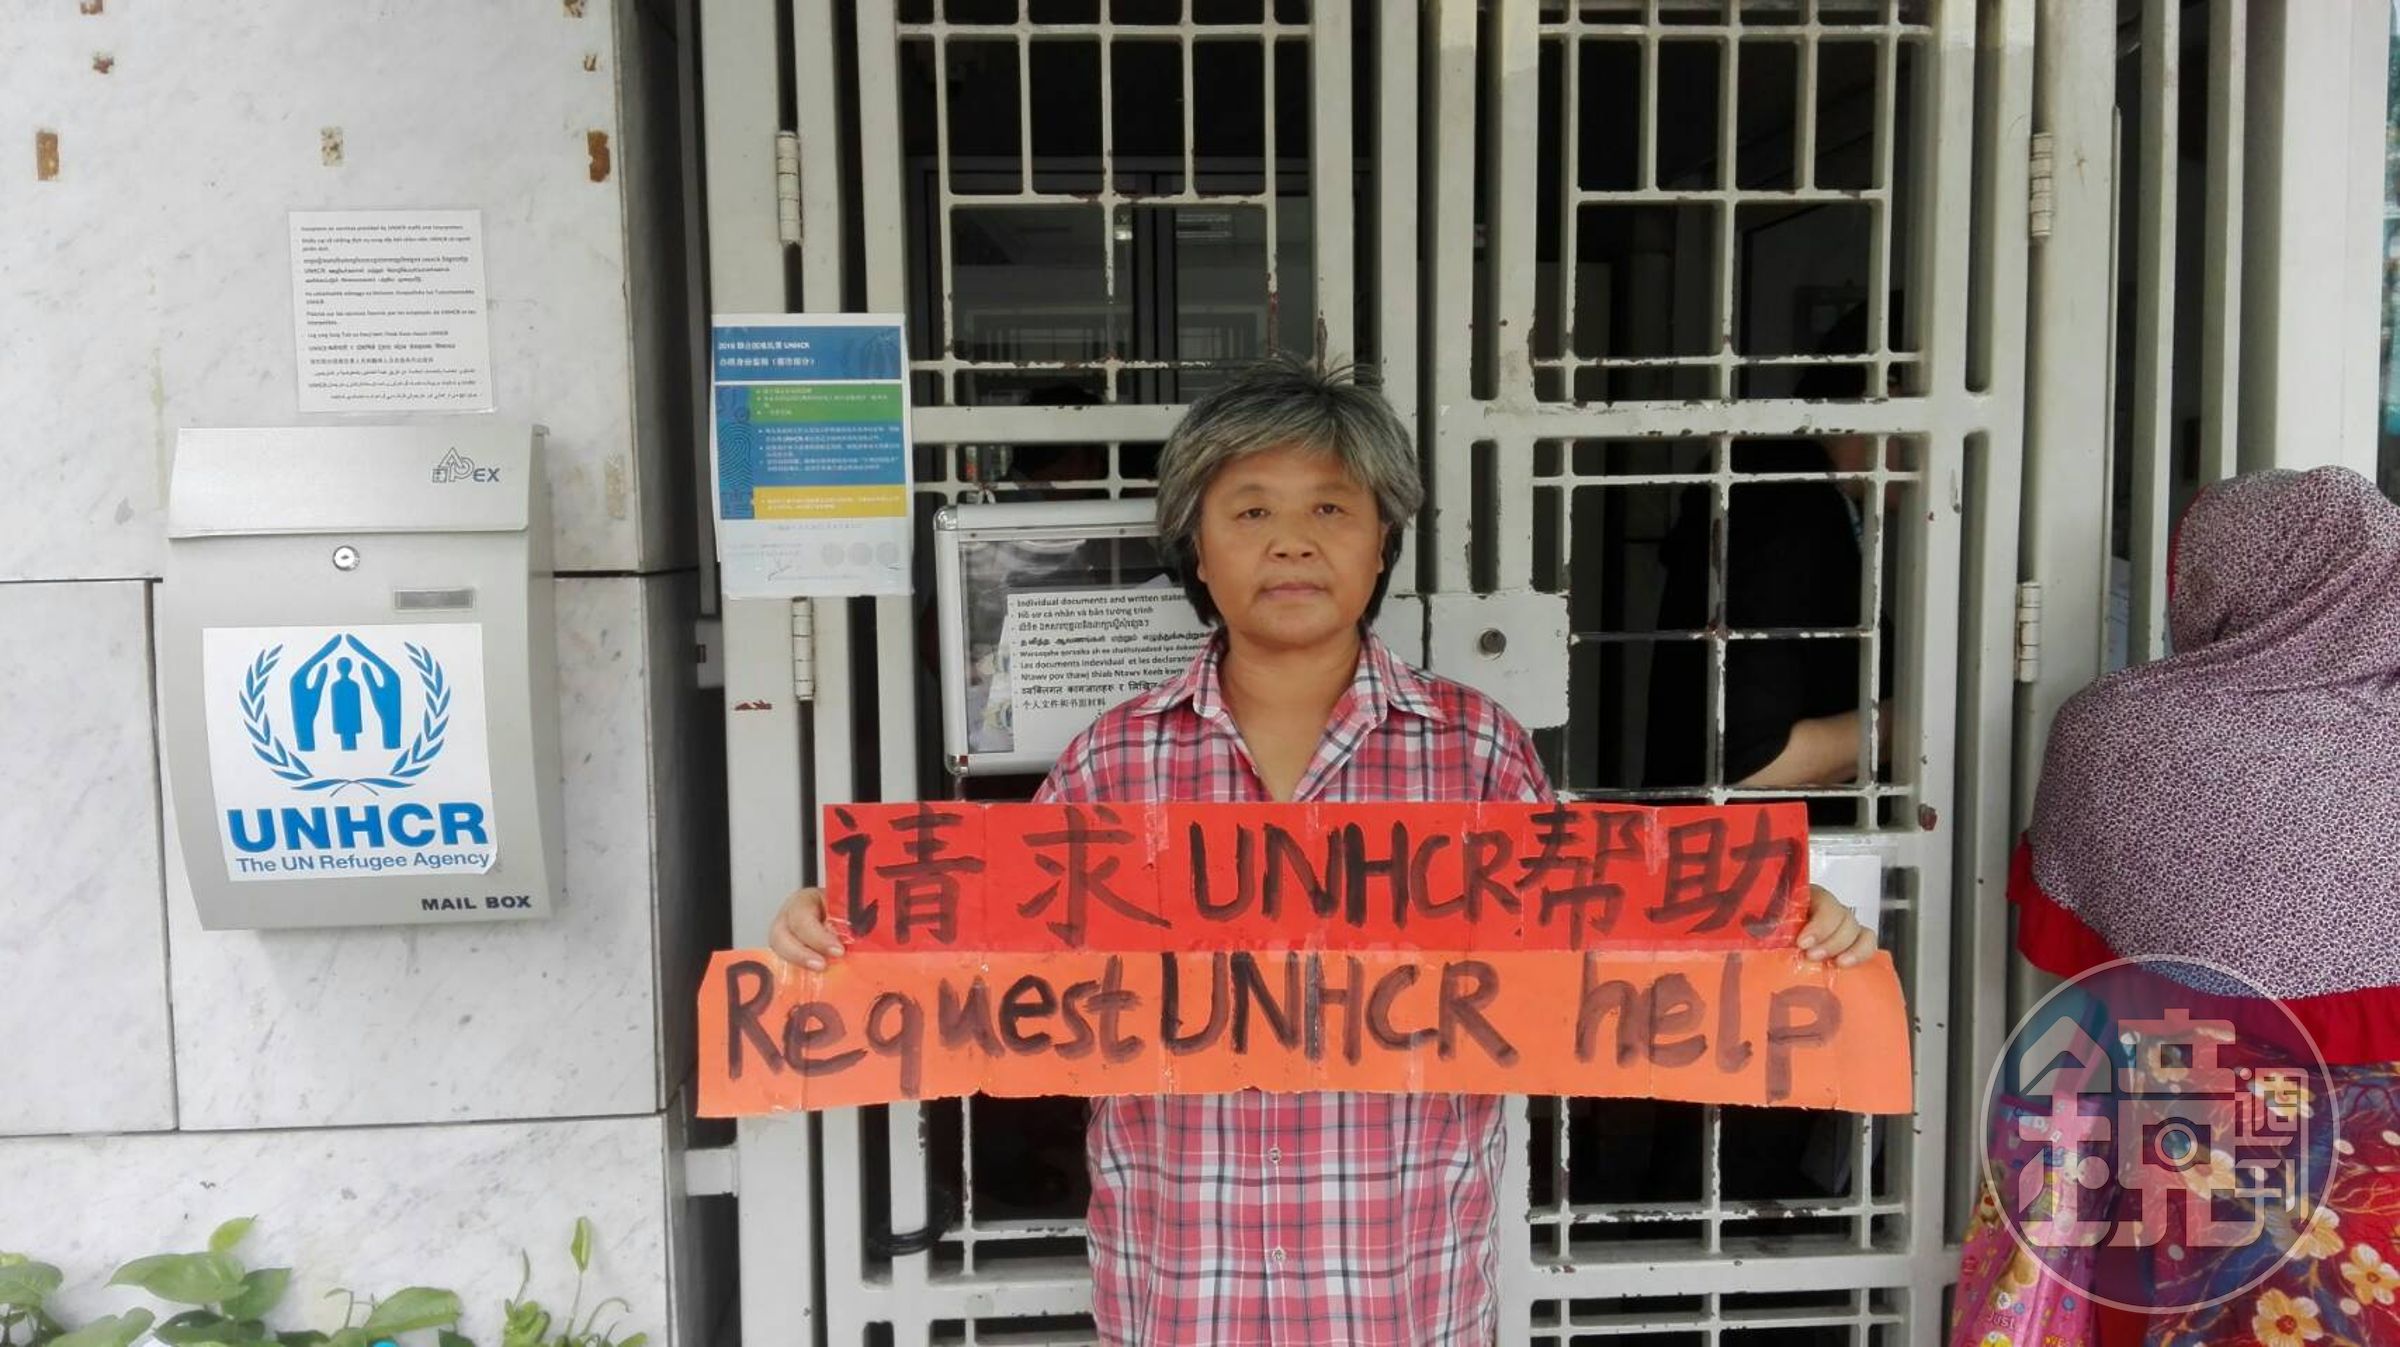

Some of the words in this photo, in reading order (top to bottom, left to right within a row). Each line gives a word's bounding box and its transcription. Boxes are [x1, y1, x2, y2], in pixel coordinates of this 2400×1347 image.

[1017, 597, 1059, 607] Individual
[1060, 596, 1108, 606] documents
[1109, 595, 1126, 603] and
[1127, 594, 1159, 602] written
[1035, 660, 1080, 669] documents
[227, 802, 489, 853] UNHCR
[235, 857, 277, 874] The
[281, 855, 315, 871] UN
[320, 853, 408, 873] Refugee
[412, 851, 491, 870] Agency
[421, 896, 477, 911] MAIL
[485, 895, 532, 910] BOX
[726, 954, 1144, 1098] Request
[1161, 951, 1520, 1068] UNHCR
[1574, 951, 1842, 1101] help
